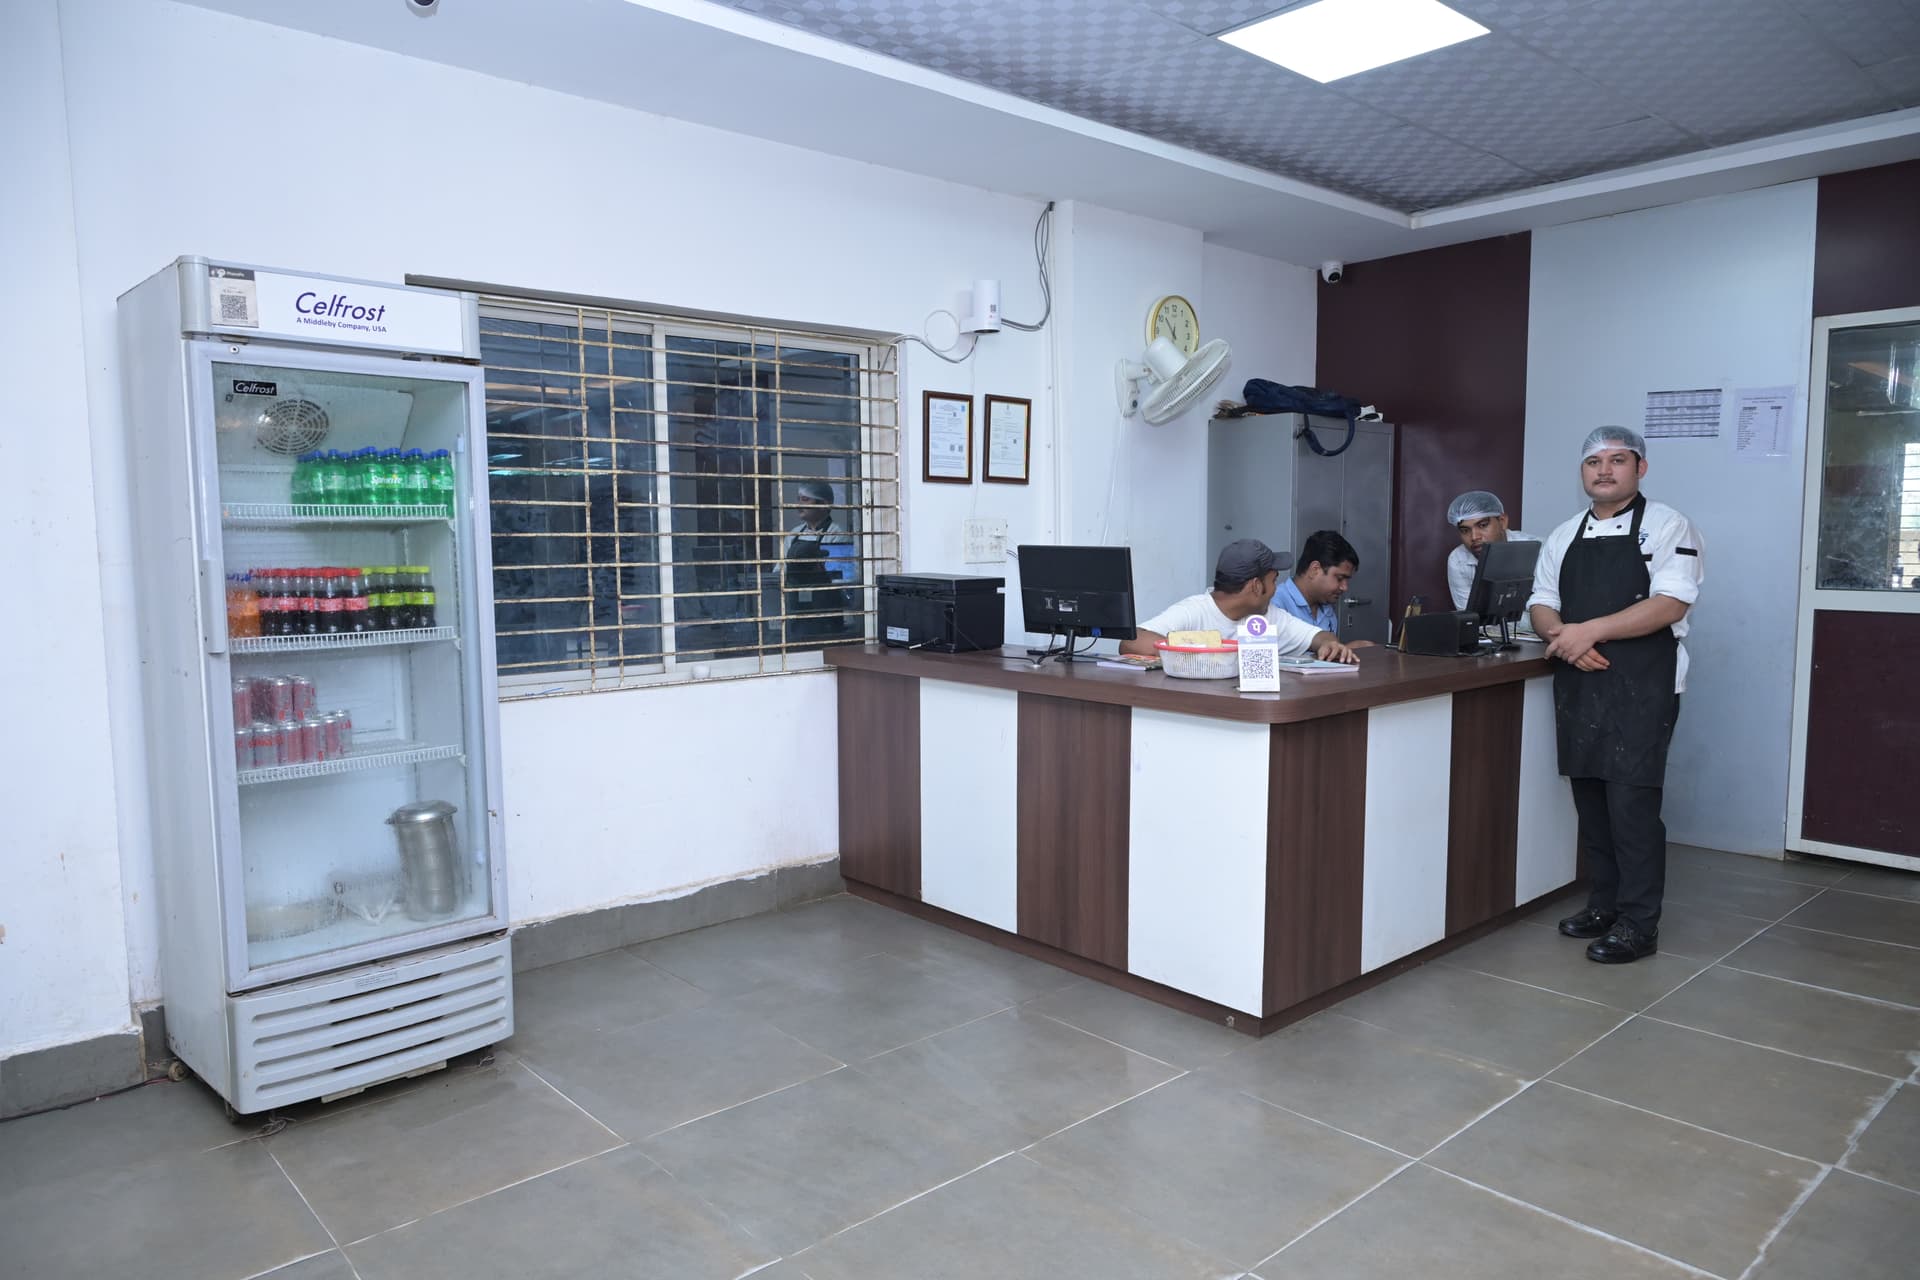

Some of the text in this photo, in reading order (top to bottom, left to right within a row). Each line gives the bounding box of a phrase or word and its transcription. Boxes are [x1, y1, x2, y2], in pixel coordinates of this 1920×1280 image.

[296, 292, 386, 322] Celfrost
[303, 318, 336, 328] Middleby
[337, 321, 371, 332] Company,
[372, 325, 387, 333] USA
[235, 382, 274, 394] Celfrost
